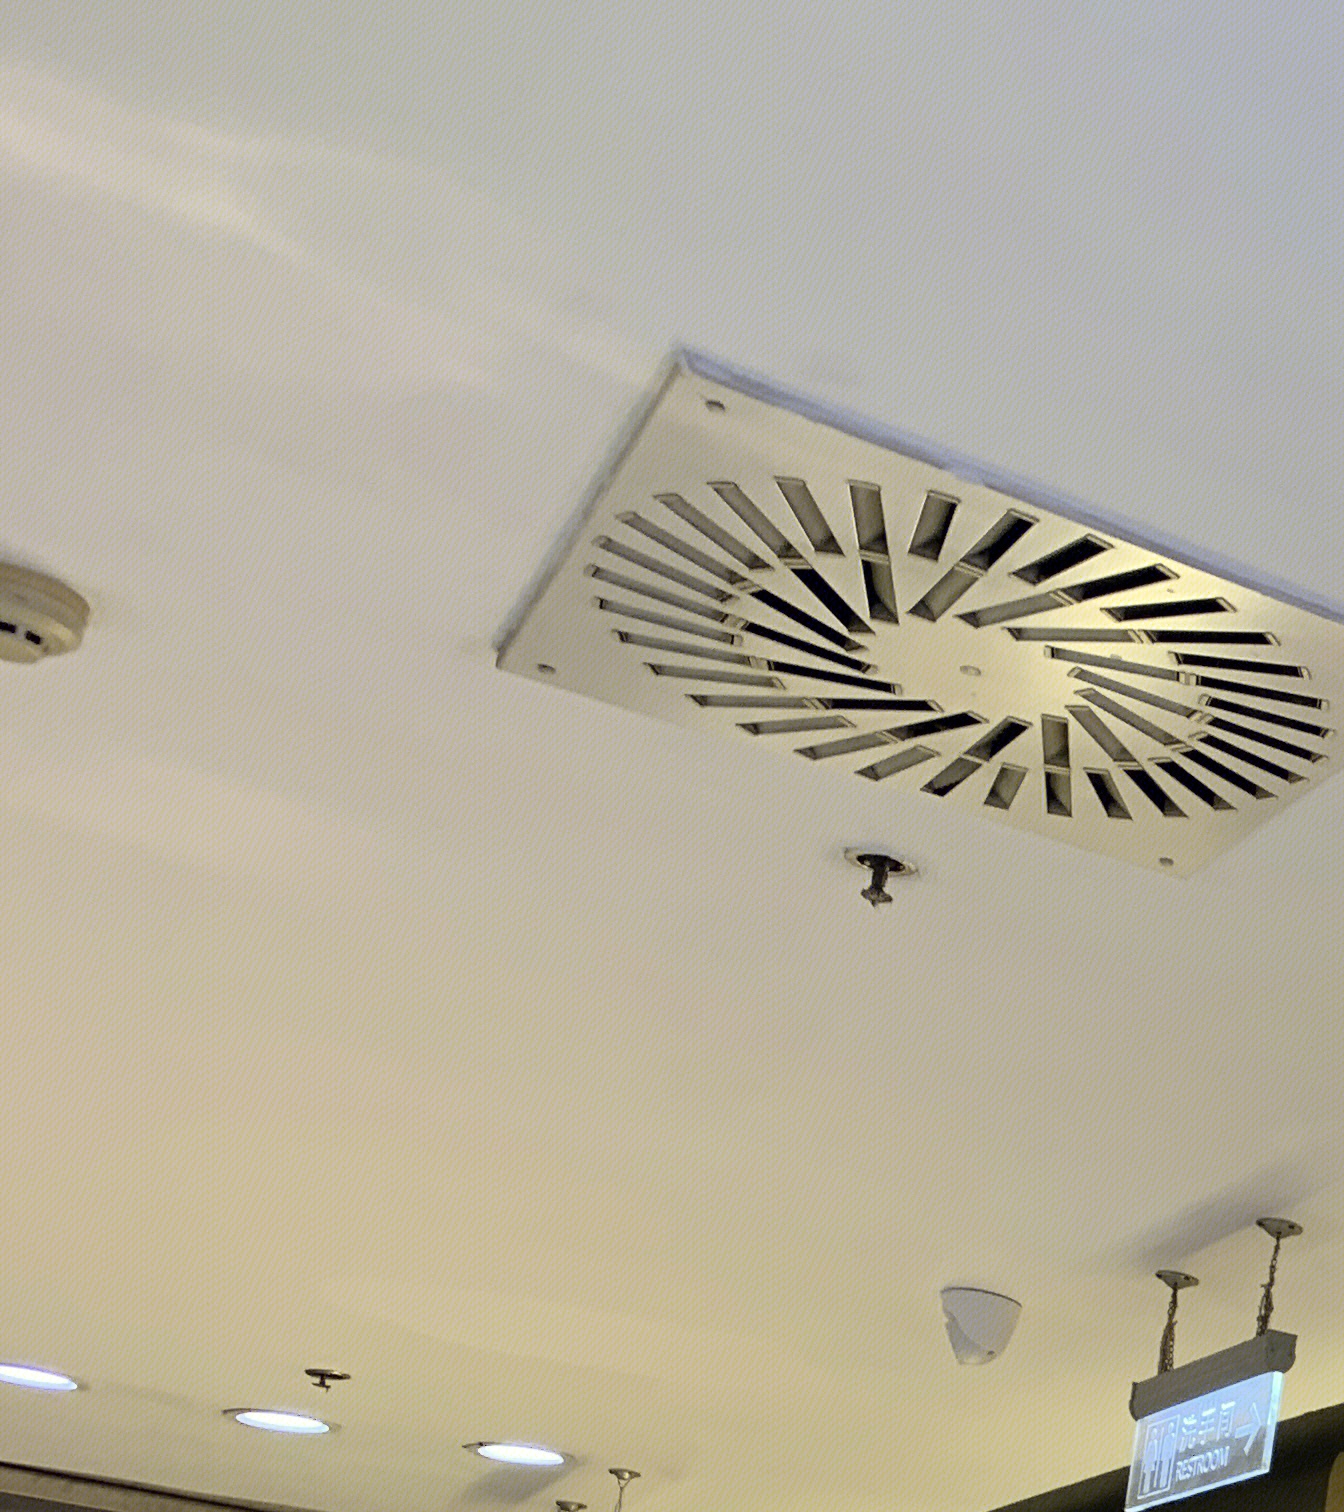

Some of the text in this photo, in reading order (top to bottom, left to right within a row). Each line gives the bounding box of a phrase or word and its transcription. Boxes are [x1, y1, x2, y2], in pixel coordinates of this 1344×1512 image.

[1179, 1400, 1237, 1454] 洗手间
[1175, 1446, 1231, 1483] RESTROOM
